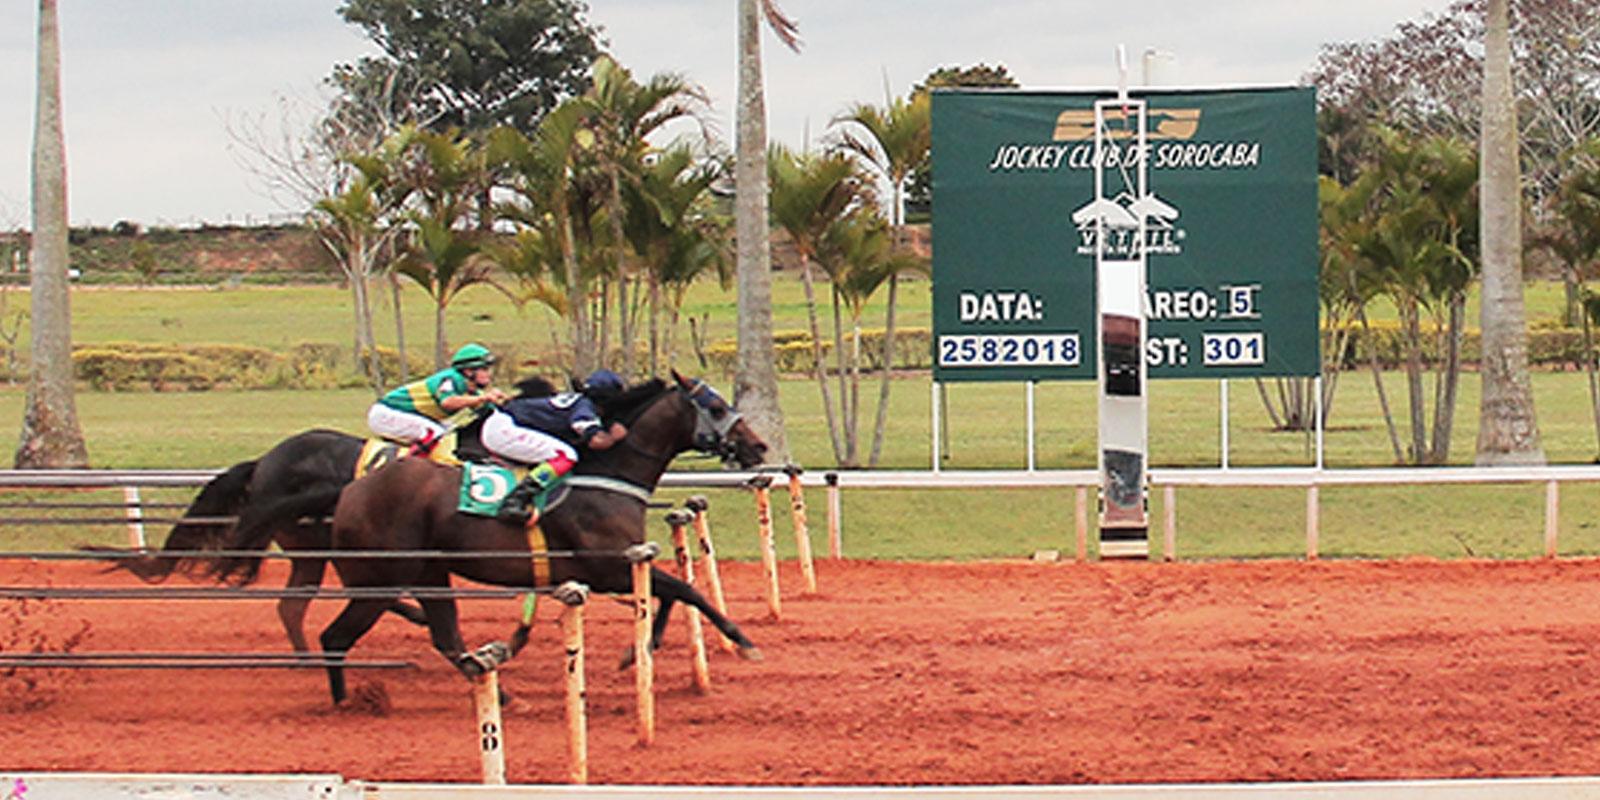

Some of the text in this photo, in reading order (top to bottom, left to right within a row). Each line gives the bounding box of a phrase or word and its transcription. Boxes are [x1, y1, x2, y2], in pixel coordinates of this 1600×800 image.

[988, 144, 1068, 170] JOCKEY
[1068, 144, 1122, 169] CLUB
[1154, 142, 1260, 168] SOROCABA
[960, 293, 1044, 321] DATA:
[1233, 289, 1249, 314] 5
[942, 337, 1078, 362] 2582018
[1206, 337, 1259, 361] 301
[470, 464, 508, 503] 5
[482, 721, 499, 752] 8
